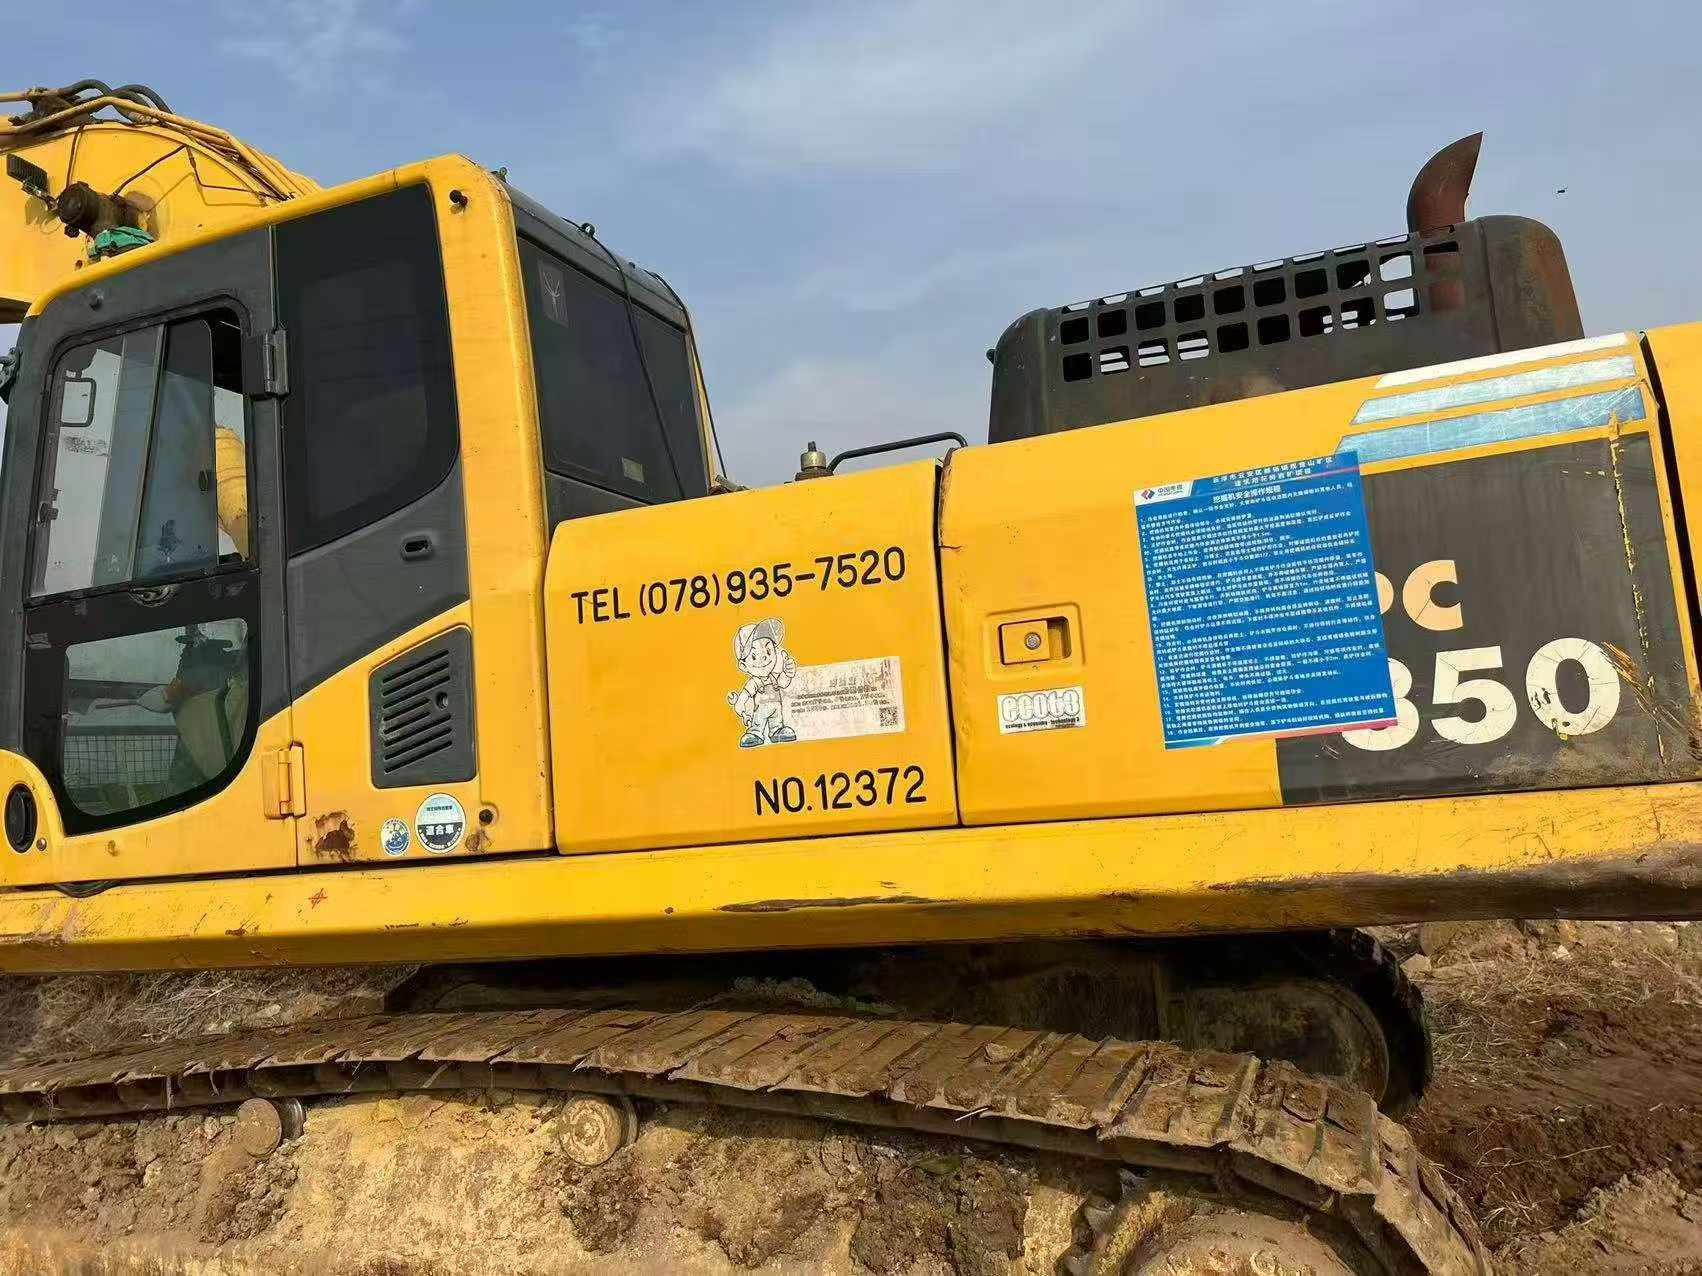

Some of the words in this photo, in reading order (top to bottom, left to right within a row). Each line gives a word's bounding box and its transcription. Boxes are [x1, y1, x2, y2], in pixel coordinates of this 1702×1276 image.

[1213, 485, 1281, 503] 挖掘机安全操作规程
[571, 590, 631, 624] TEL
[639, 546, 906, 616] (078)935-7520
[754, 765, 927, 816] NO.12372
